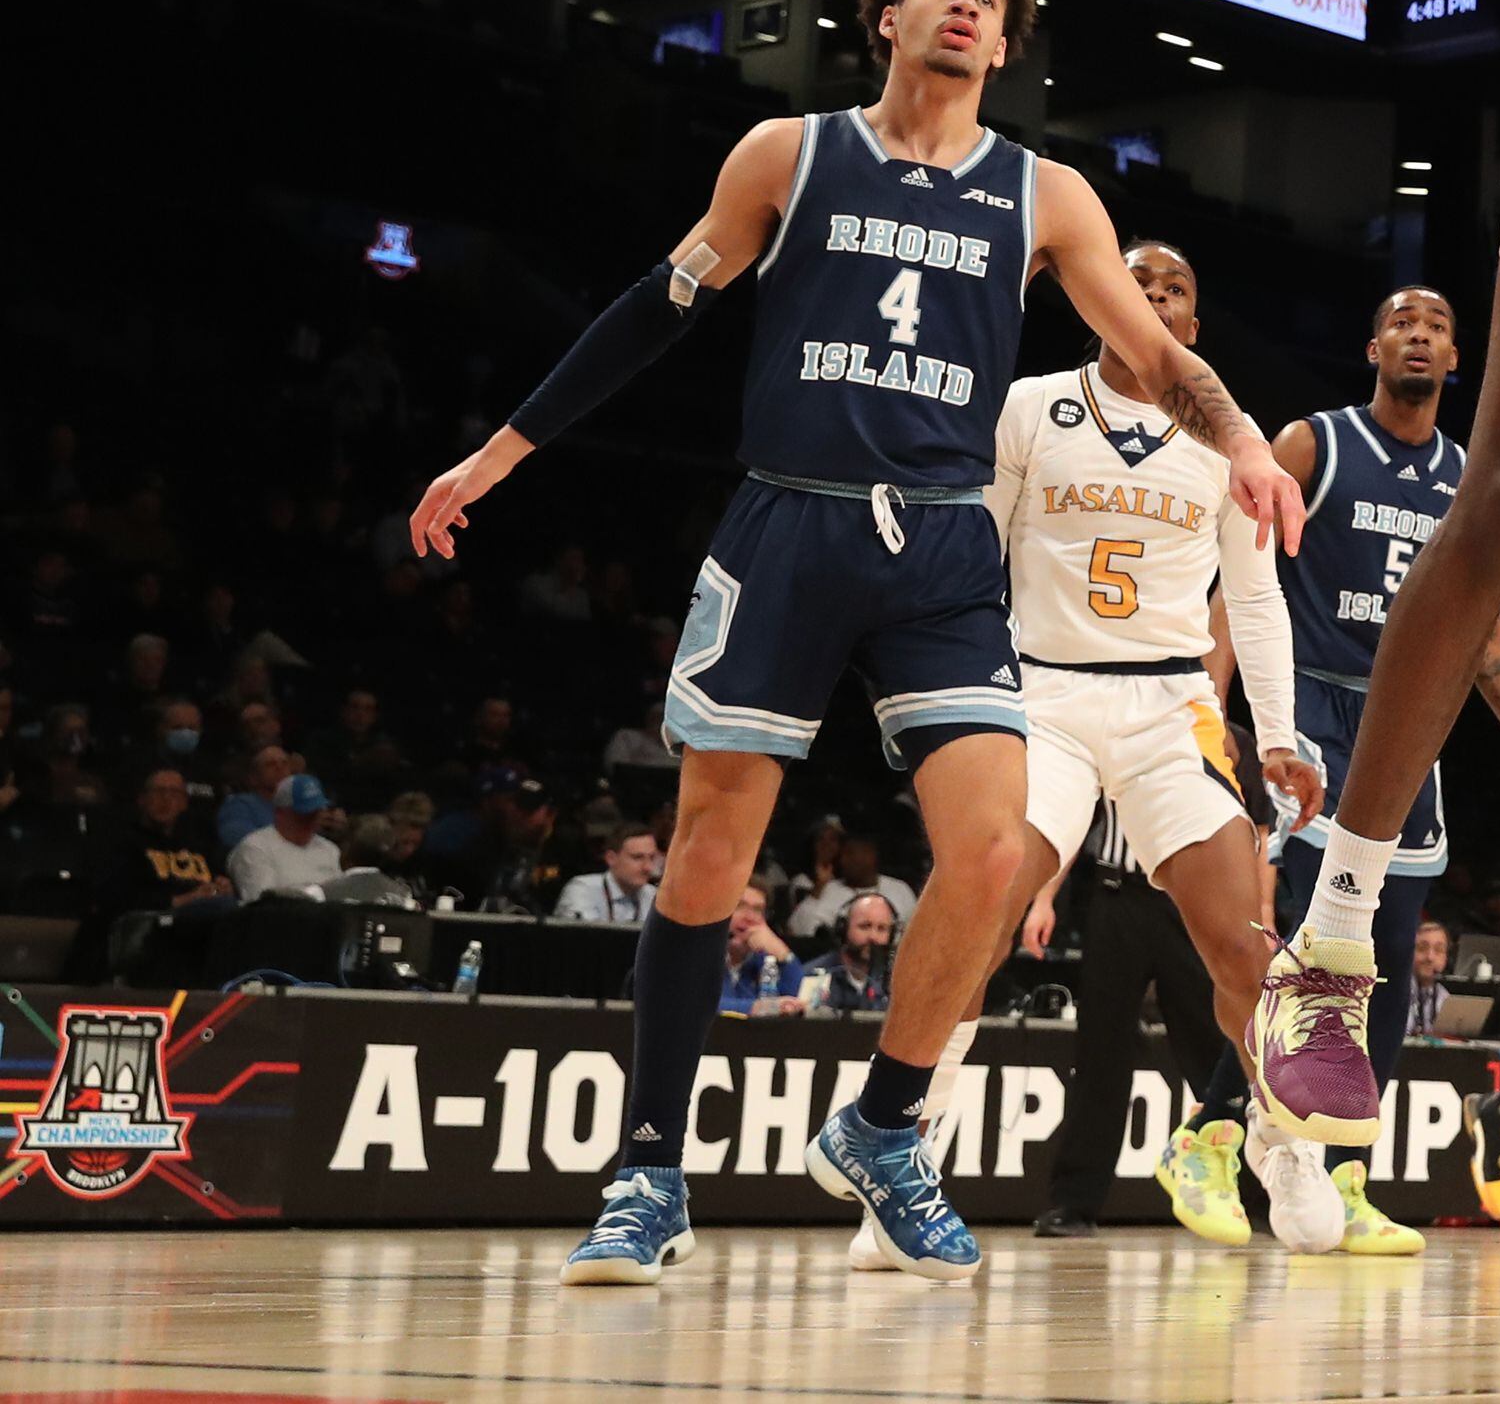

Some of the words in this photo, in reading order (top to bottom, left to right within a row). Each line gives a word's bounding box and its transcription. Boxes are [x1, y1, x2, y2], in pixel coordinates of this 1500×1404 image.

[900, 175, 935, 189] adidas
[959, 187, 1016, 211] A10
[826, 213, 991, 278] RHODE
[876, 266, 923, 346] 4
[800, 341, 975, 407] ISLAND
[1056, 412, 1077, 424] ED
[1058, 401, 1083, 416] BR.
[1042, 483, 1207, 534] LASALLE
[1351, 500, 1443, 544] RHOD
[1087, 537, 1145, 620] 5
[1383, 538, 1415, 595] 5
[990, 675, 1018, 689] adidas
[1330, 878, 1362, 895] adidas
[66, 1089, 140, 1112] A10
[328, 1043, 626, 1174] A-10
[36, 1126, 169, 1145] CHAMPIONSHIP
[65, 1166, 127, 1190] BROOKLYN
